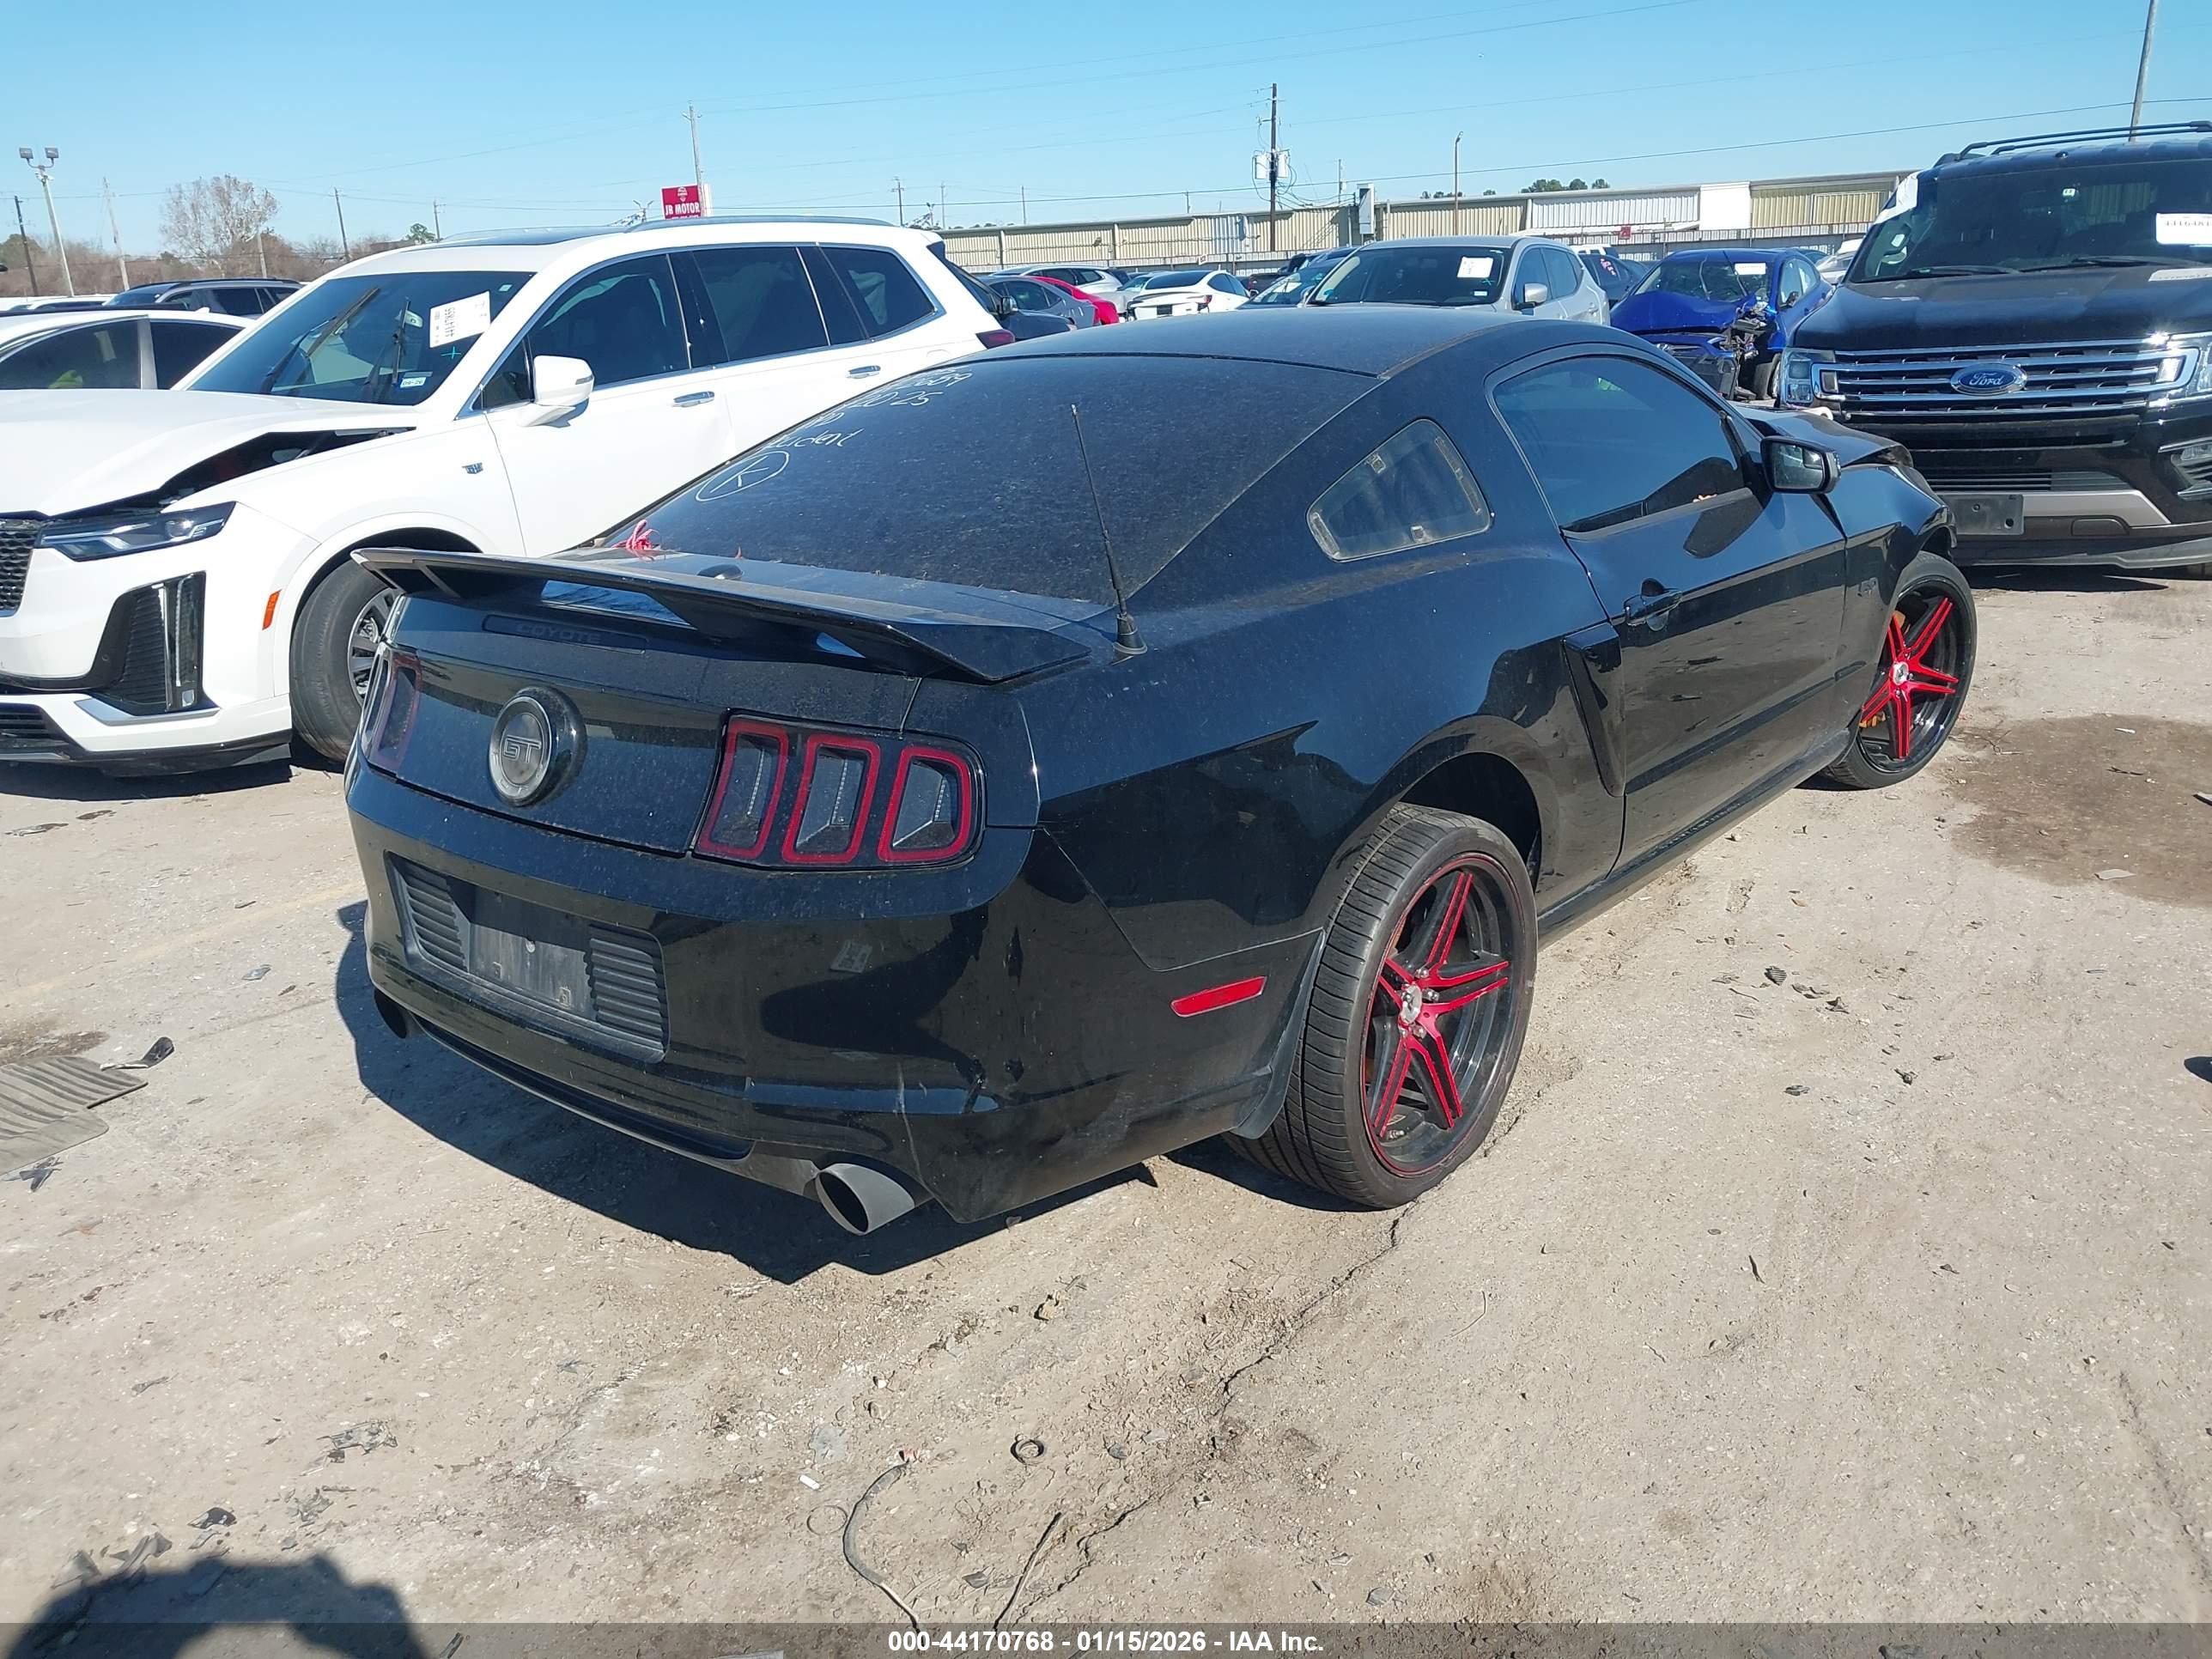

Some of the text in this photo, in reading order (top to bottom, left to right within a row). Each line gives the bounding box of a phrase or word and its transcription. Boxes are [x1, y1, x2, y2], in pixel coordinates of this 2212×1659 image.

[665, 201, 701, 216] JB MOTOR
[1968, 372, 2005, 386] Ford
[516, 623, 601, 644] COYOTE
